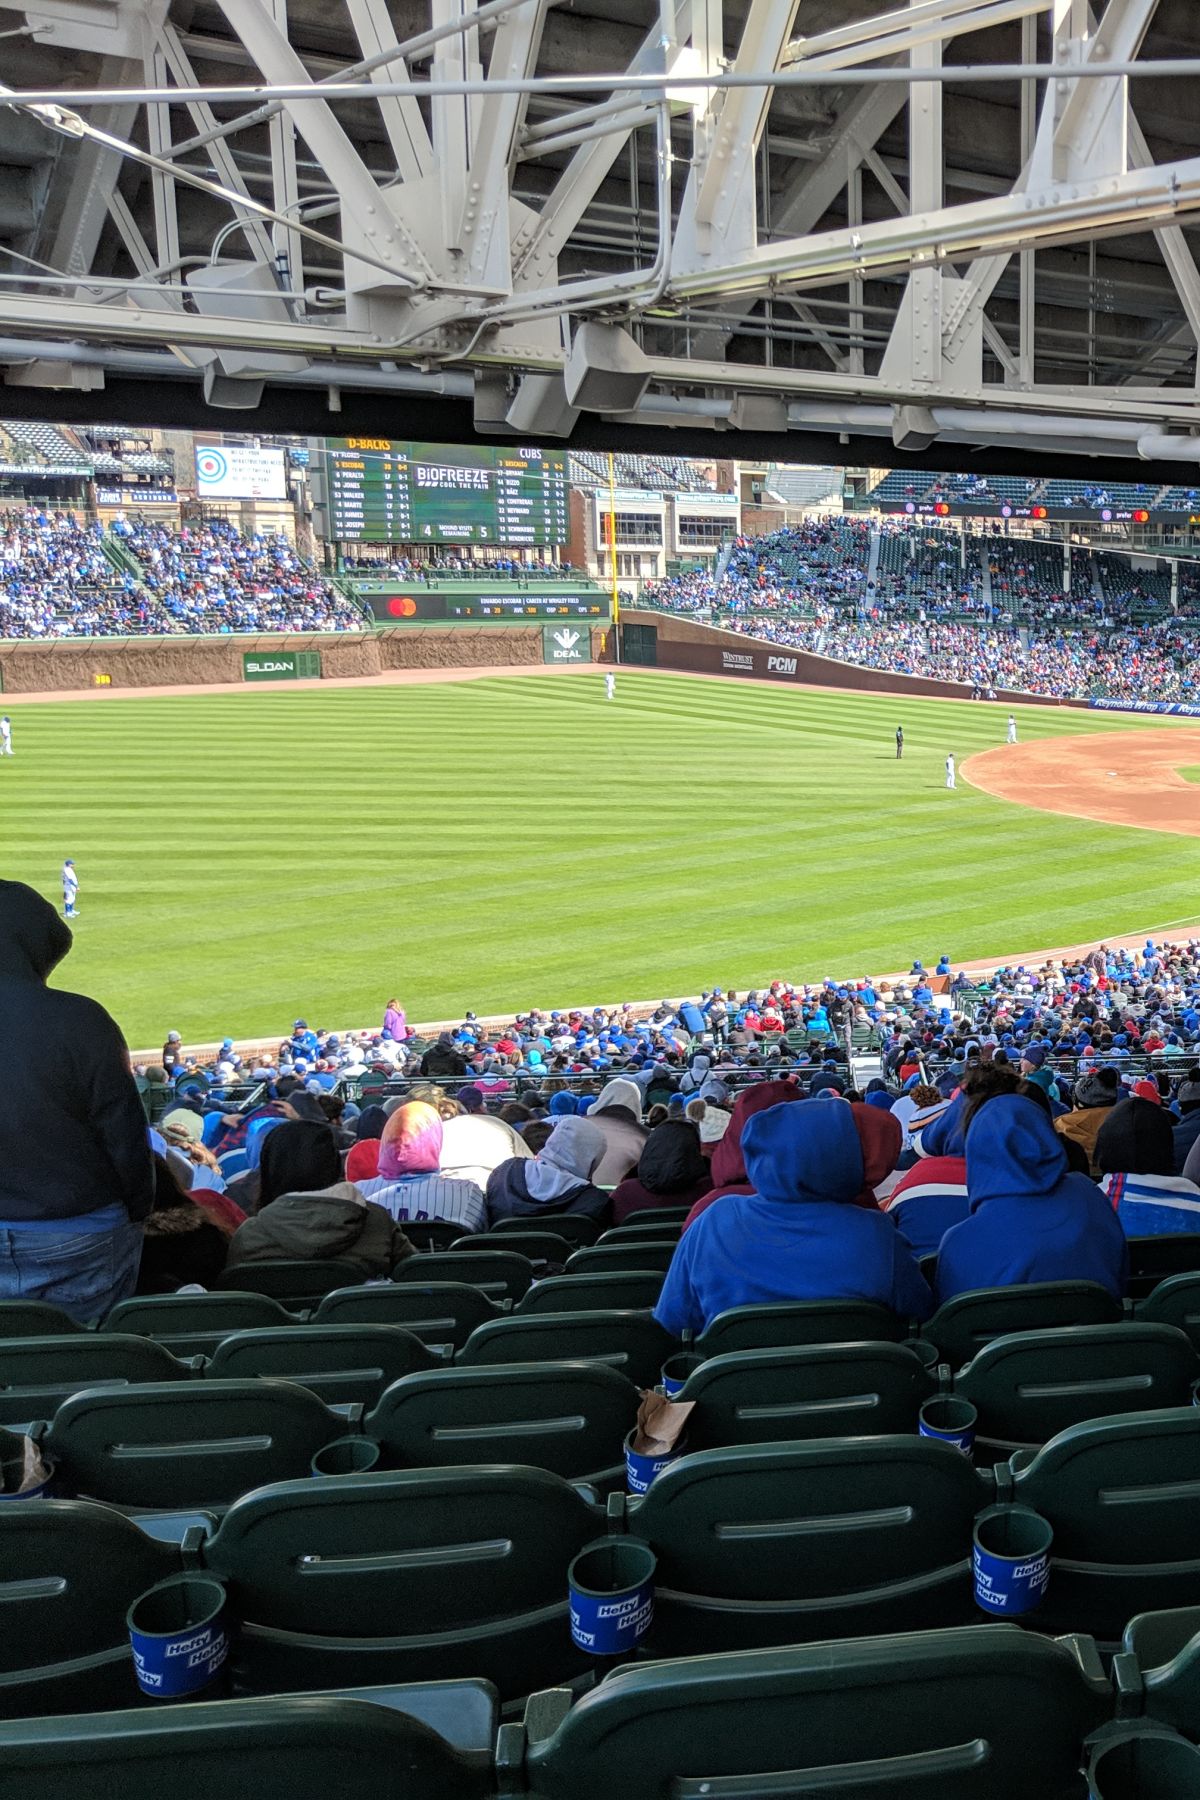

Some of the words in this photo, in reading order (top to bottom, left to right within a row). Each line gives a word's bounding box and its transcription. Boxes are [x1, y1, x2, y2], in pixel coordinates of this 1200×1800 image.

[348, 438, 391, 450] D-BACKS
[520, 448, 542, 459] CUBS
[342, 461, 365, 469] ESCOBAR
[473, 482, 489, 490] PAIN
[343, 491, 365, 499] WALKER
[344, 501, 363, 509] MARTE
[344, 511, 364, 519] AHMED
[1015, 507, 1032, 516] prefer
[1116, 511, 1132, 520] prefer
[424, 525, 432, 536] 4
[480, 526, 488, 537] 5
[553, 650, 582, 658] IDEAL
[246, 661, 294, 673] SLOAN
[767, 655, 798, 672] PCM
[1094, 699, 1134, 709] Reynolds
[1134, 701, 1159, 712] Wrap
[1014, 1557, 1047, 1577] Hefty
[600, 1598, 639, 1617] Hefty
[168, 1631, 211, 1656] Hefty
